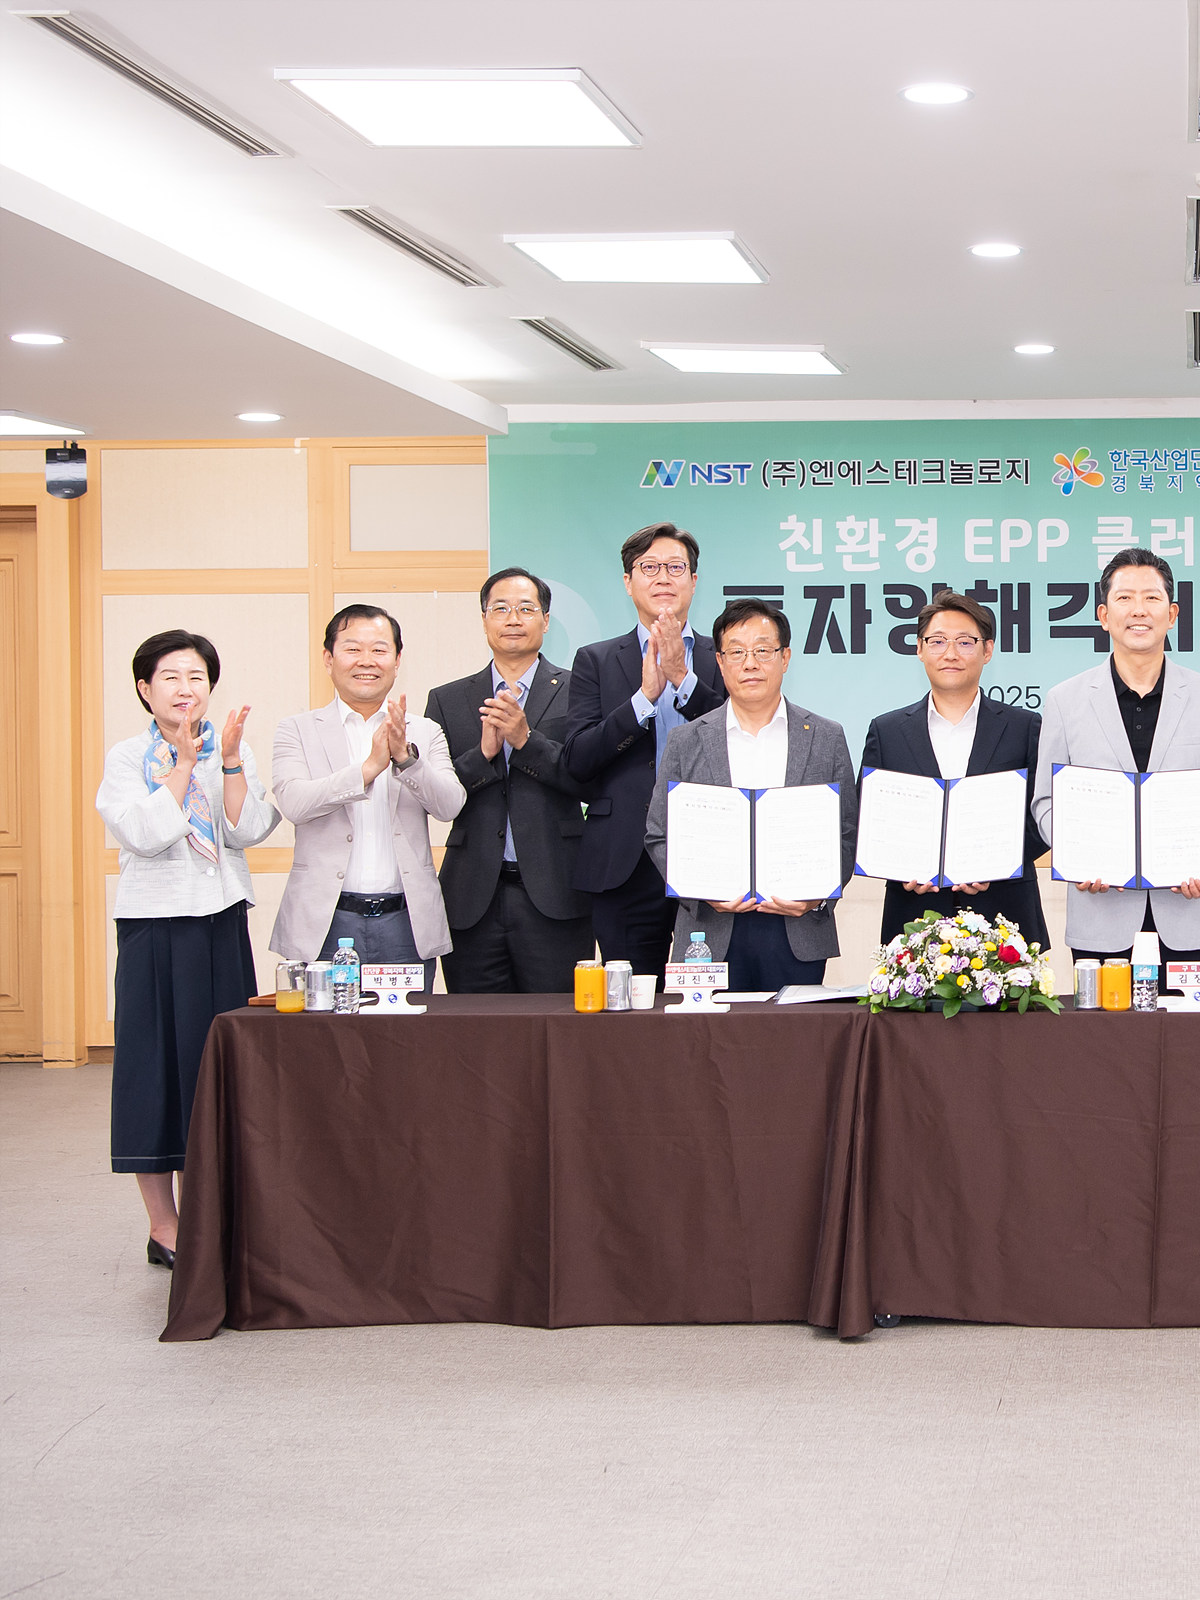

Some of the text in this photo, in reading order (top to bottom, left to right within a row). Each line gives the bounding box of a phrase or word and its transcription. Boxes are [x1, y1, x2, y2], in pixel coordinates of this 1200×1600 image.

[691, 463, 753, 485] NST
[762, 459, 1031, 488] (주)엔에스테크놀로지
[778, 513, 939, 573] 친환경
[964, 517, 1070, 564] EPP
[979, 685, 1042, 709] 025
